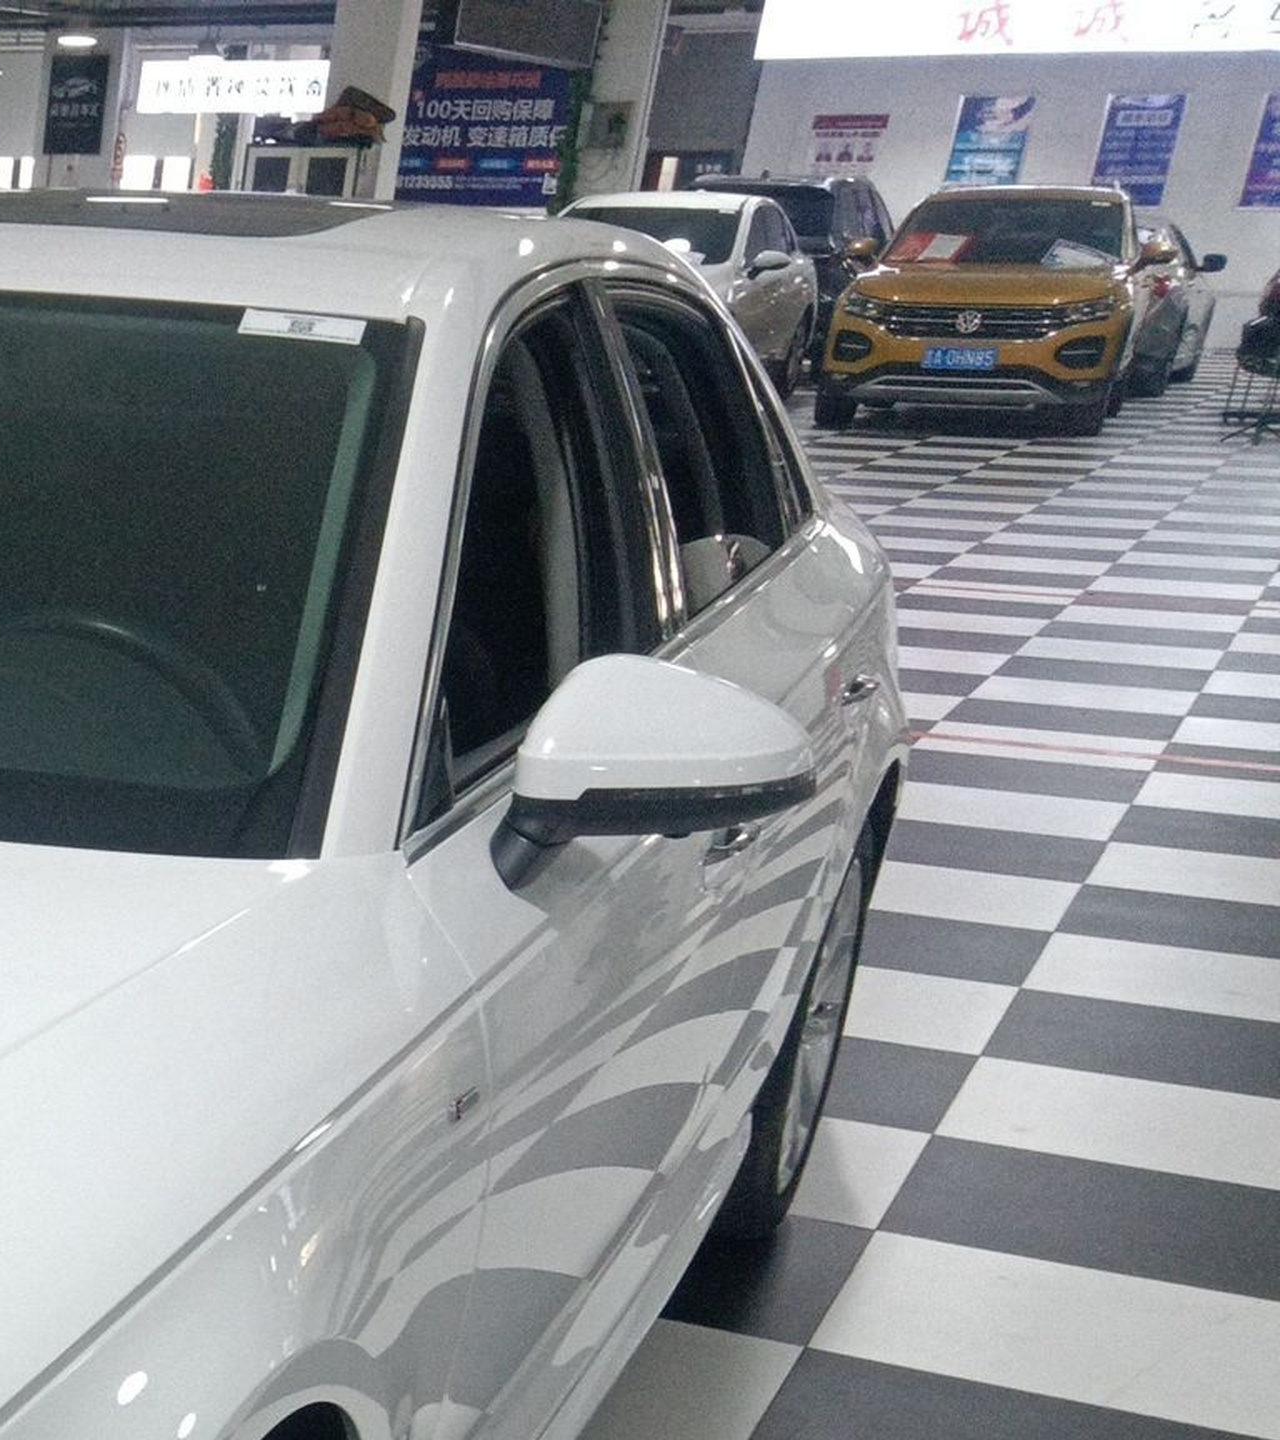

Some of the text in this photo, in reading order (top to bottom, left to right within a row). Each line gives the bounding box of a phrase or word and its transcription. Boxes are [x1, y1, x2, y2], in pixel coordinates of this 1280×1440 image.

[416, 99, 555, 121] 100天回购保障
